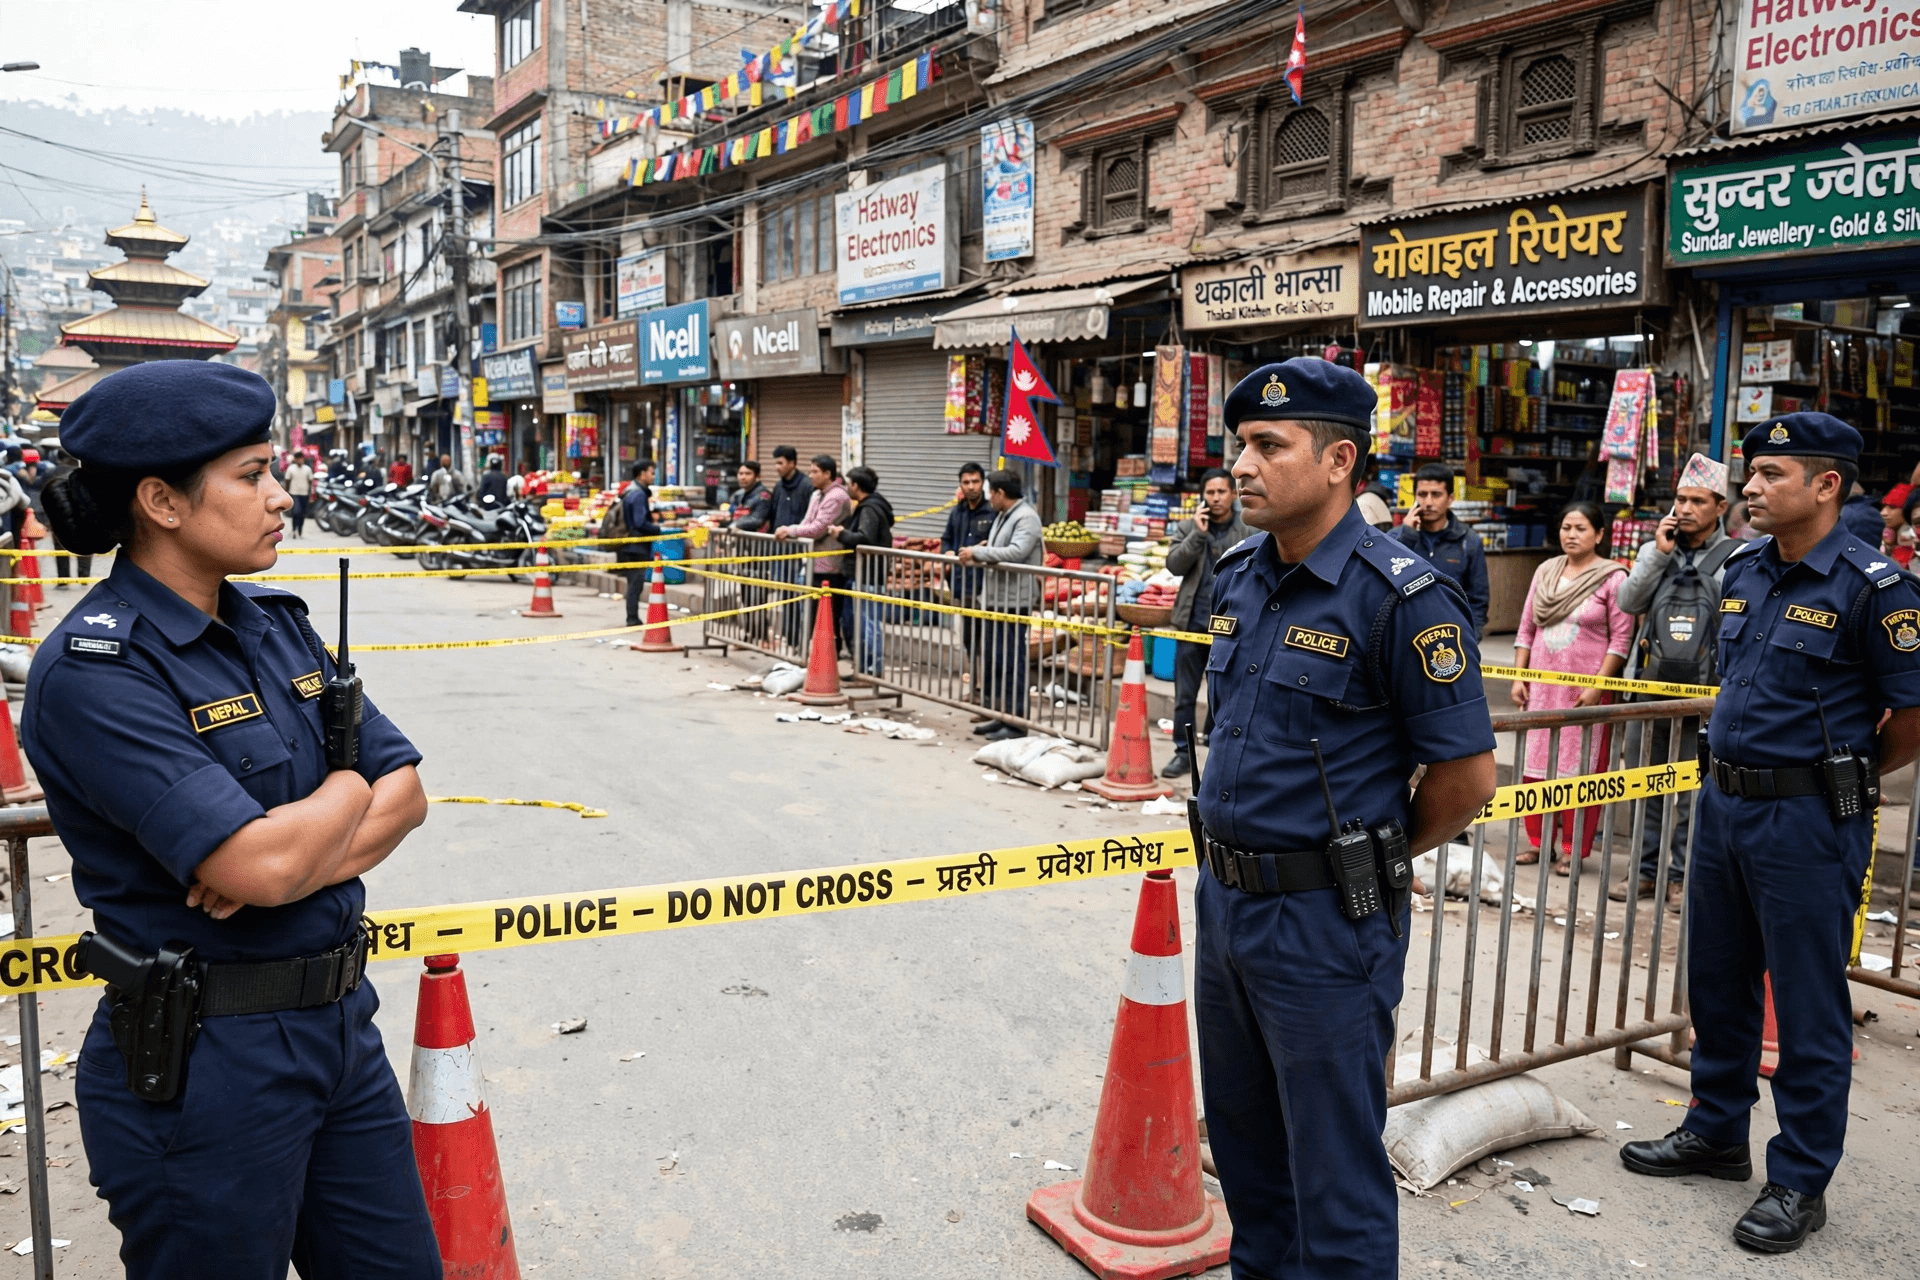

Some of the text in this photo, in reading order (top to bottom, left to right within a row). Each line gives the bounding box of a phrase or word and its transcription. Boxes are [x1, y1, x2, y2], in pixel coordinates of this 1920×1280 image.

[859, 190, 918, 225] Hatway
[1682, 165, 1796, 232] सुन्दर
[848, 221, 936, 261] Electronics
[1371, 204, 1627, 279] मोबाइल रिपेयर
[1681, 228, 1735, 254] Sundar
[1738, 221, 1815, 247] Jewellery
[1830, 211, 1871, 239] Gold
[1874, 210, 1887, 234] &
[1195, 264, 1343, 306] थकाली भान्सा
[1368, 287, 1423, 317] Mobile
[1428, 280, 1487, 315] Repair
[1492, 278, 1506, 305] &
[1511, 266, 1637, 303] Accessories
[650, 313, 699, 361] Ncell
[753, 320, 799, 355] Ncell
[1420, 628, 1454, 647] NEPAL
[1794, 609, 1829, 624] POLICE
[1295, 631, 1339, 651] POLICE
[207, 700, 249, 723] NEPAL
[1515, 788, 1537, 813] DO
[1542, 784, 1571, 808] NOT
[1578, 776, 1625, 803] CROSS
[1646, 765, 1677, 793] प्रहरी
[494, 897, 618, 943] POLICE
[667, 888, 712, 924] DO
[723, 880, 786, 917] NOT
[796, 869, 893, 909] CROSS
[936, 852, 997, 892] प्रहरी
[1036, 844, 1095, 880] प्रवेश
[1102, 836, 1164, 871] निषेध
